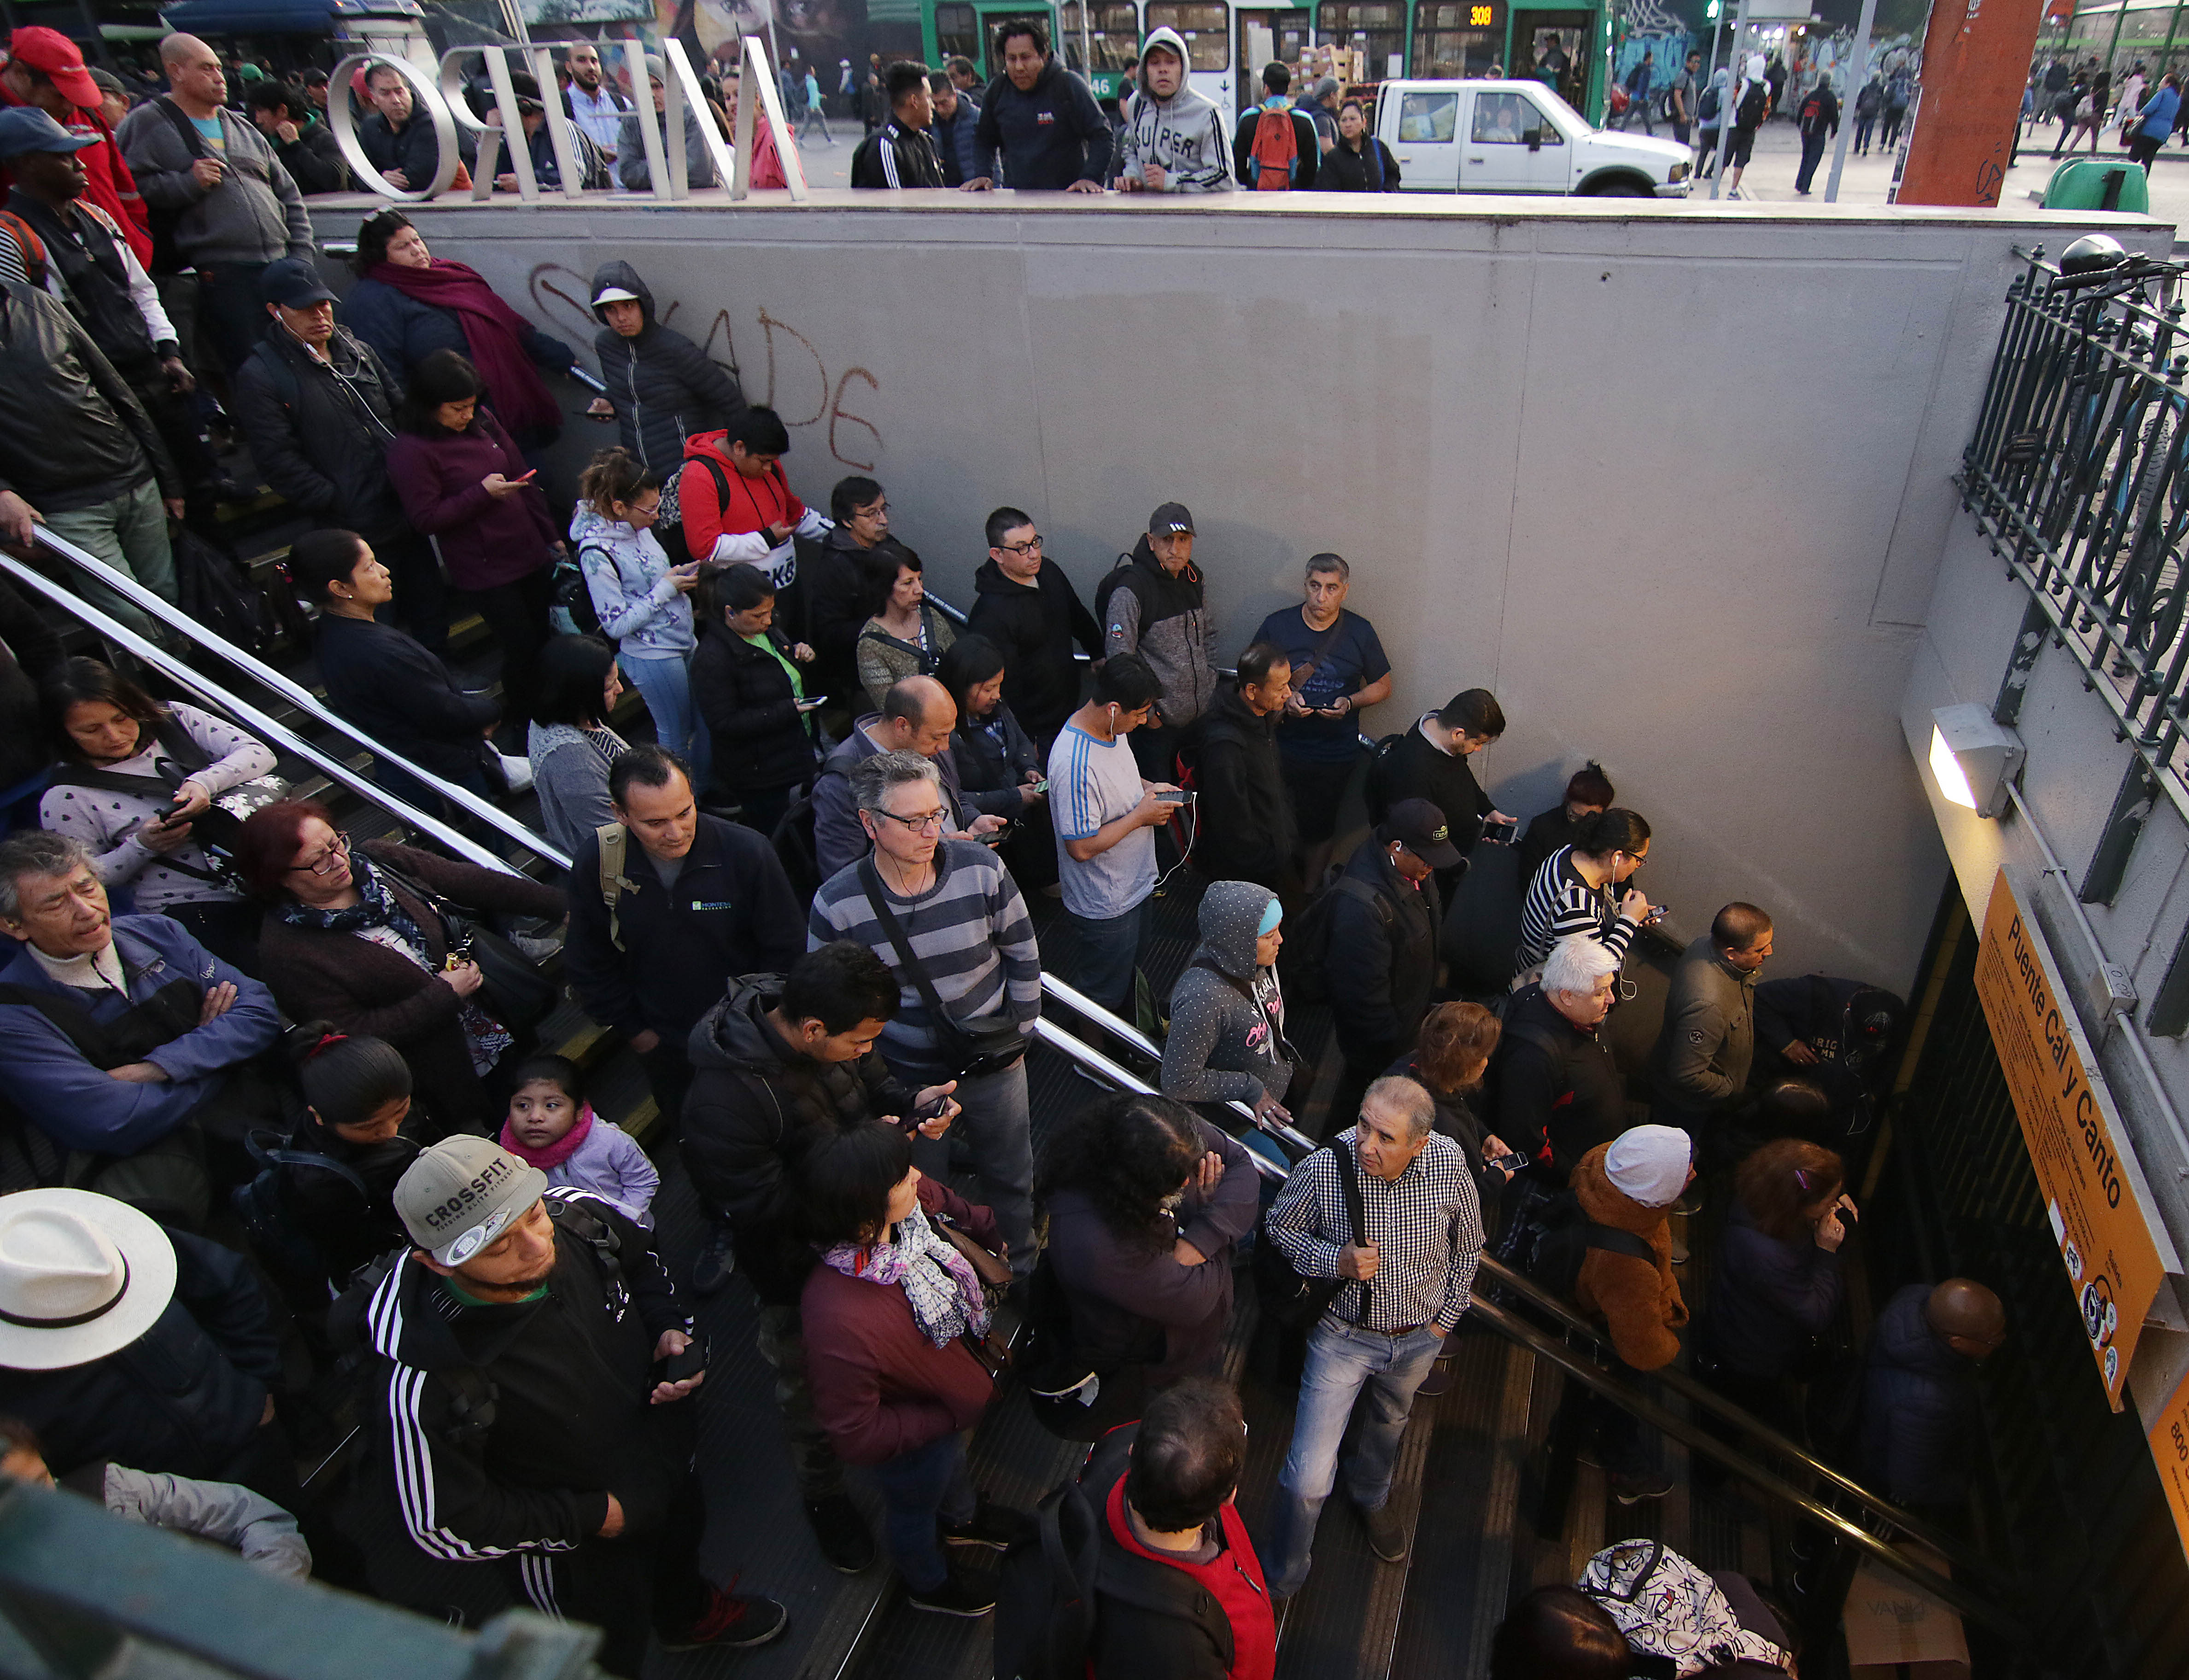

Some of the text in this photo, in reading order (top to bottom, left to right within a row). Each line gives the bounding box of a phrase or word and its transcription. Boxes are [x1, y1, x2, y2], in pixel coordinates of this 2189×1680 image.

[1470, 6, 1492, 25] 308
[2008, 914, 2045, 1016] Puente
[2045, 1009, 2070, 1074] Cal
[2062, 1065, 2078, 1098] y
[2077, 1090, 2120, 1208] Canto
[426, 1157, 507, 1226] CROSSFIT
[468, 1192, 489, 1211] ELITE
[491, 1169, 513, 1191] FITNESS
[2171, 1421, 2188, 1461] 800
